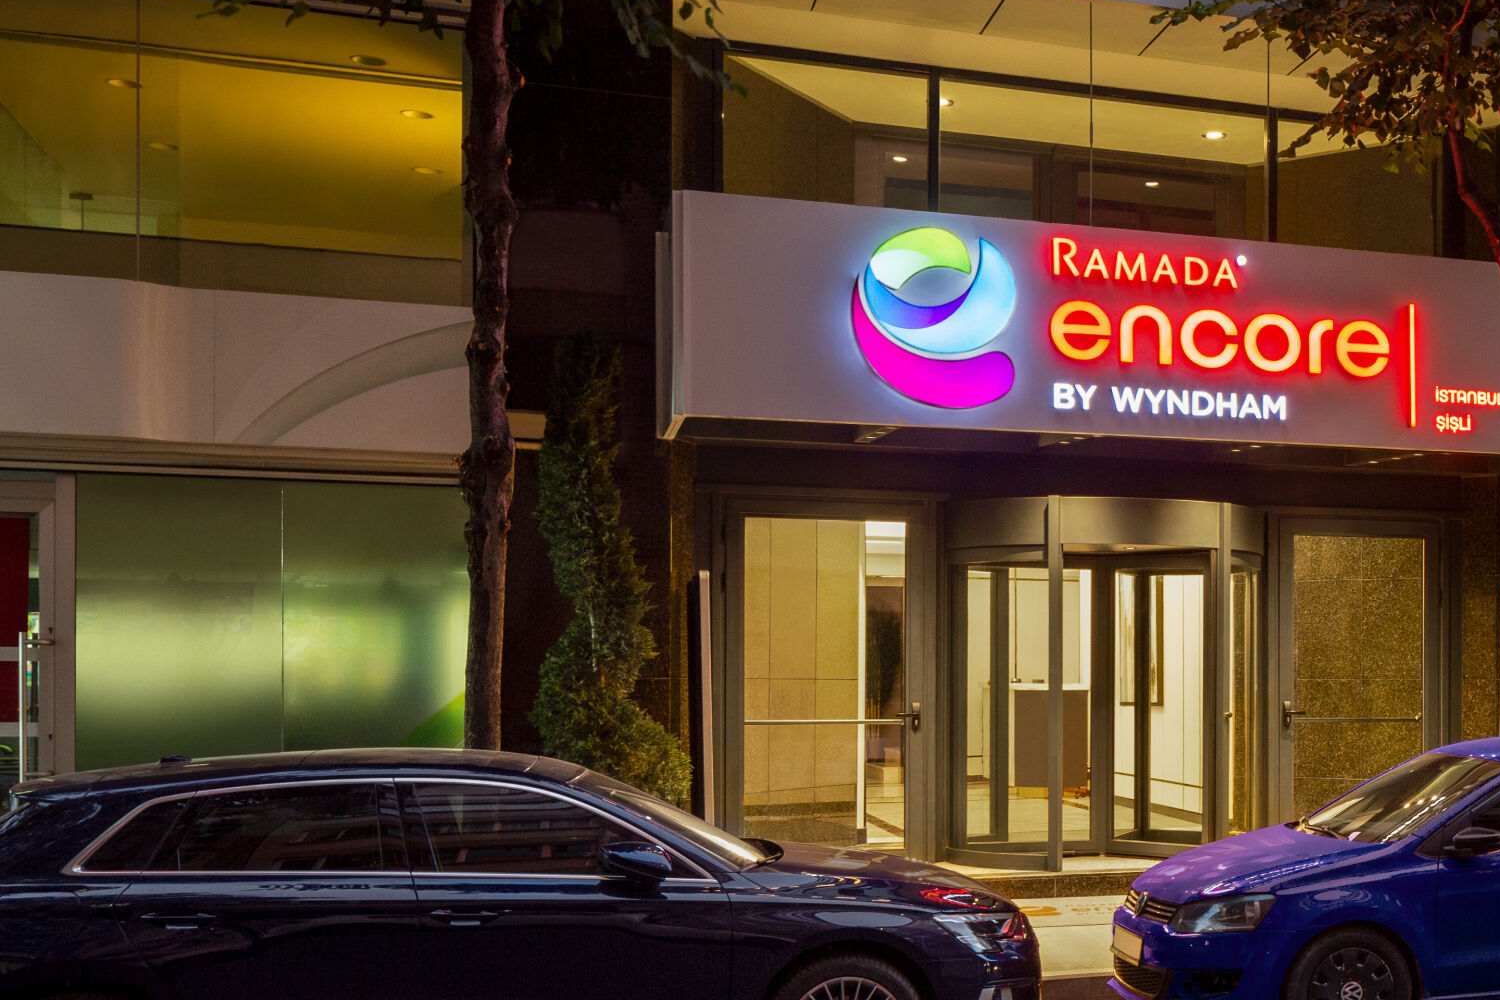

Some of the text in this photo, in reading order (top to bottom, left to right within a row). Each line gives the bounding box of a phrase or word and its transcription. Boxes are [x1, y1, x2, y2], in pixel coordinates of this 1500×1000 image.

[1052, 237, 1238, 289] RAMADA
[1050, 300, 1390, 378] encore
[1053, 382, 1288, 421] BY WYNDHAM
[1435, 412, 1472, 433] ŞİŞLİ
